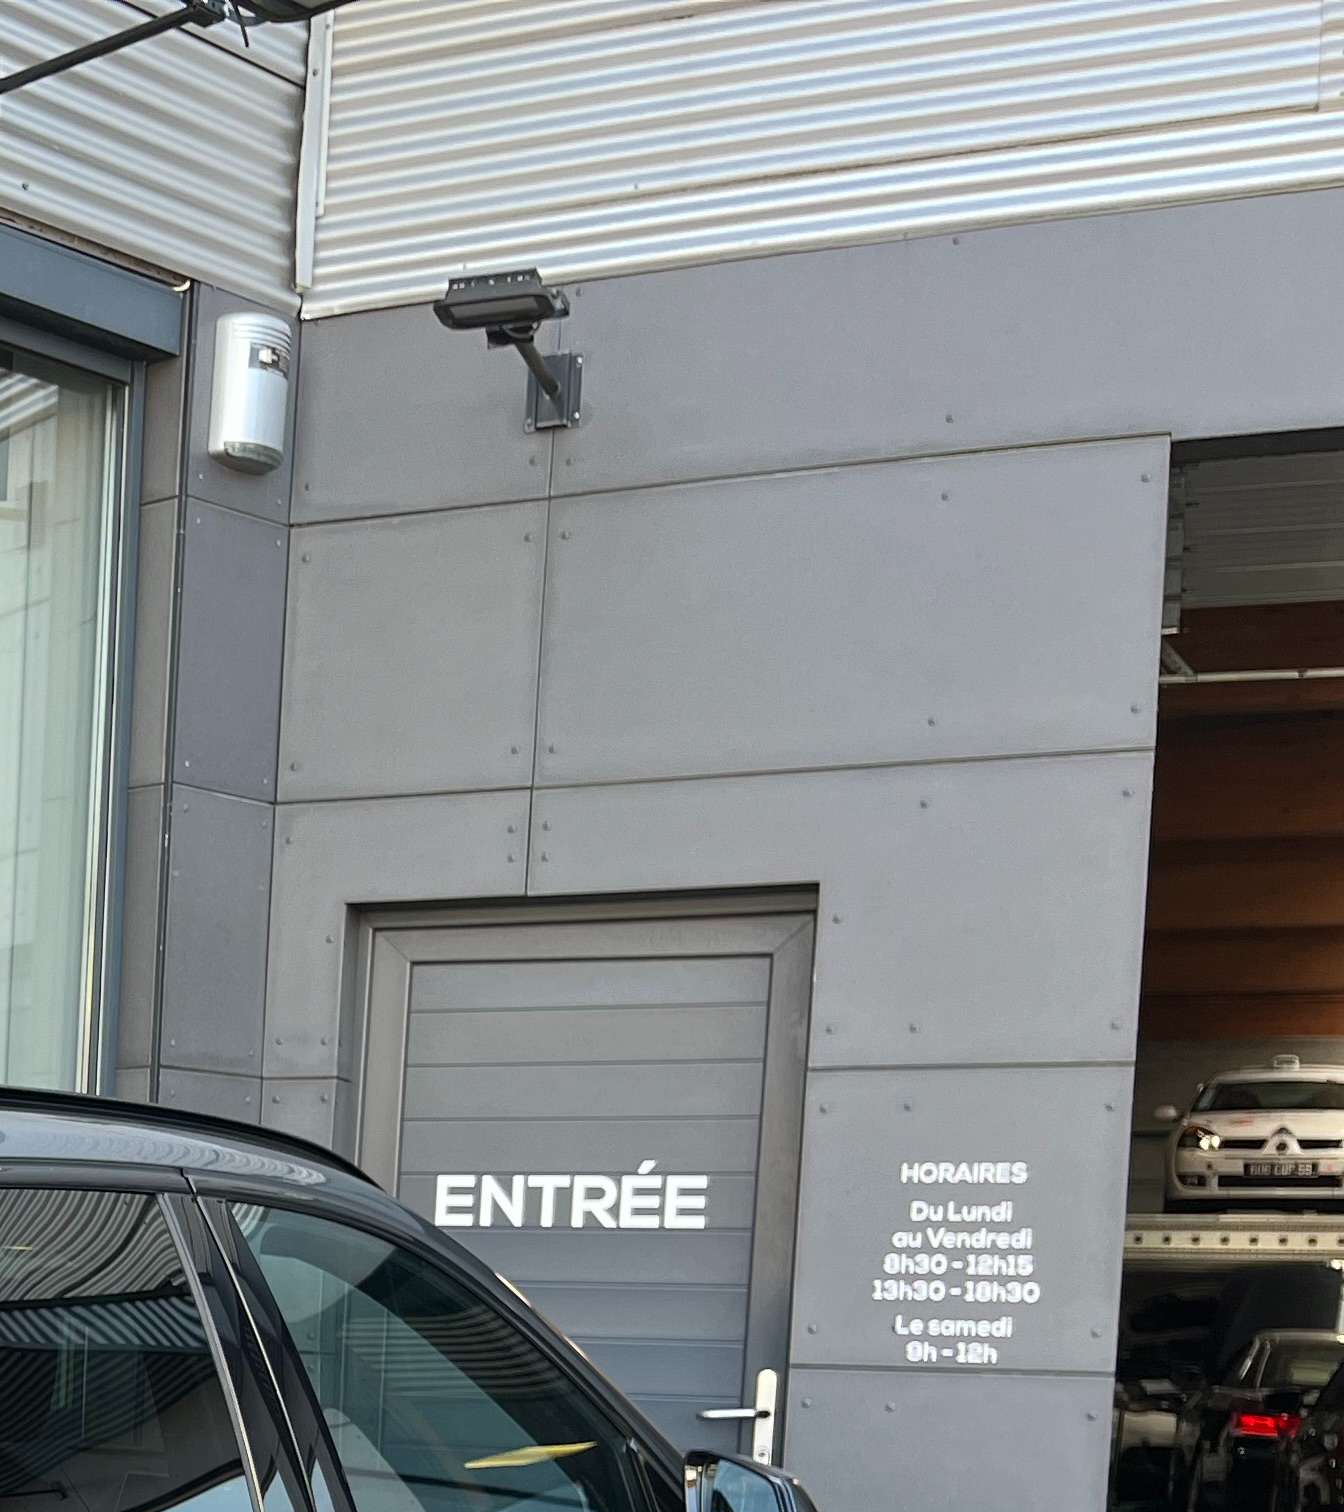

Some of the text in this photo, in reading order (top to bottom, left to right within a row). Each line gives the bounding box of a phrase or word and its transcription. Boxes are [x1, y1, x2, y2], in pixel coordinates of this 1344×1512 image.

[900, 1161, 1029, 1184] HORAIRES
[434, 1159, 708, 1229] ENTRÉE
[909, 1200, 1013, 1223] Du Lundi
[891, 1227, 1033, 1250] au Vendredi
[871, 1279, 947, 1302] 13h30
[894, 1314, 1013, 1338] Le samedi
